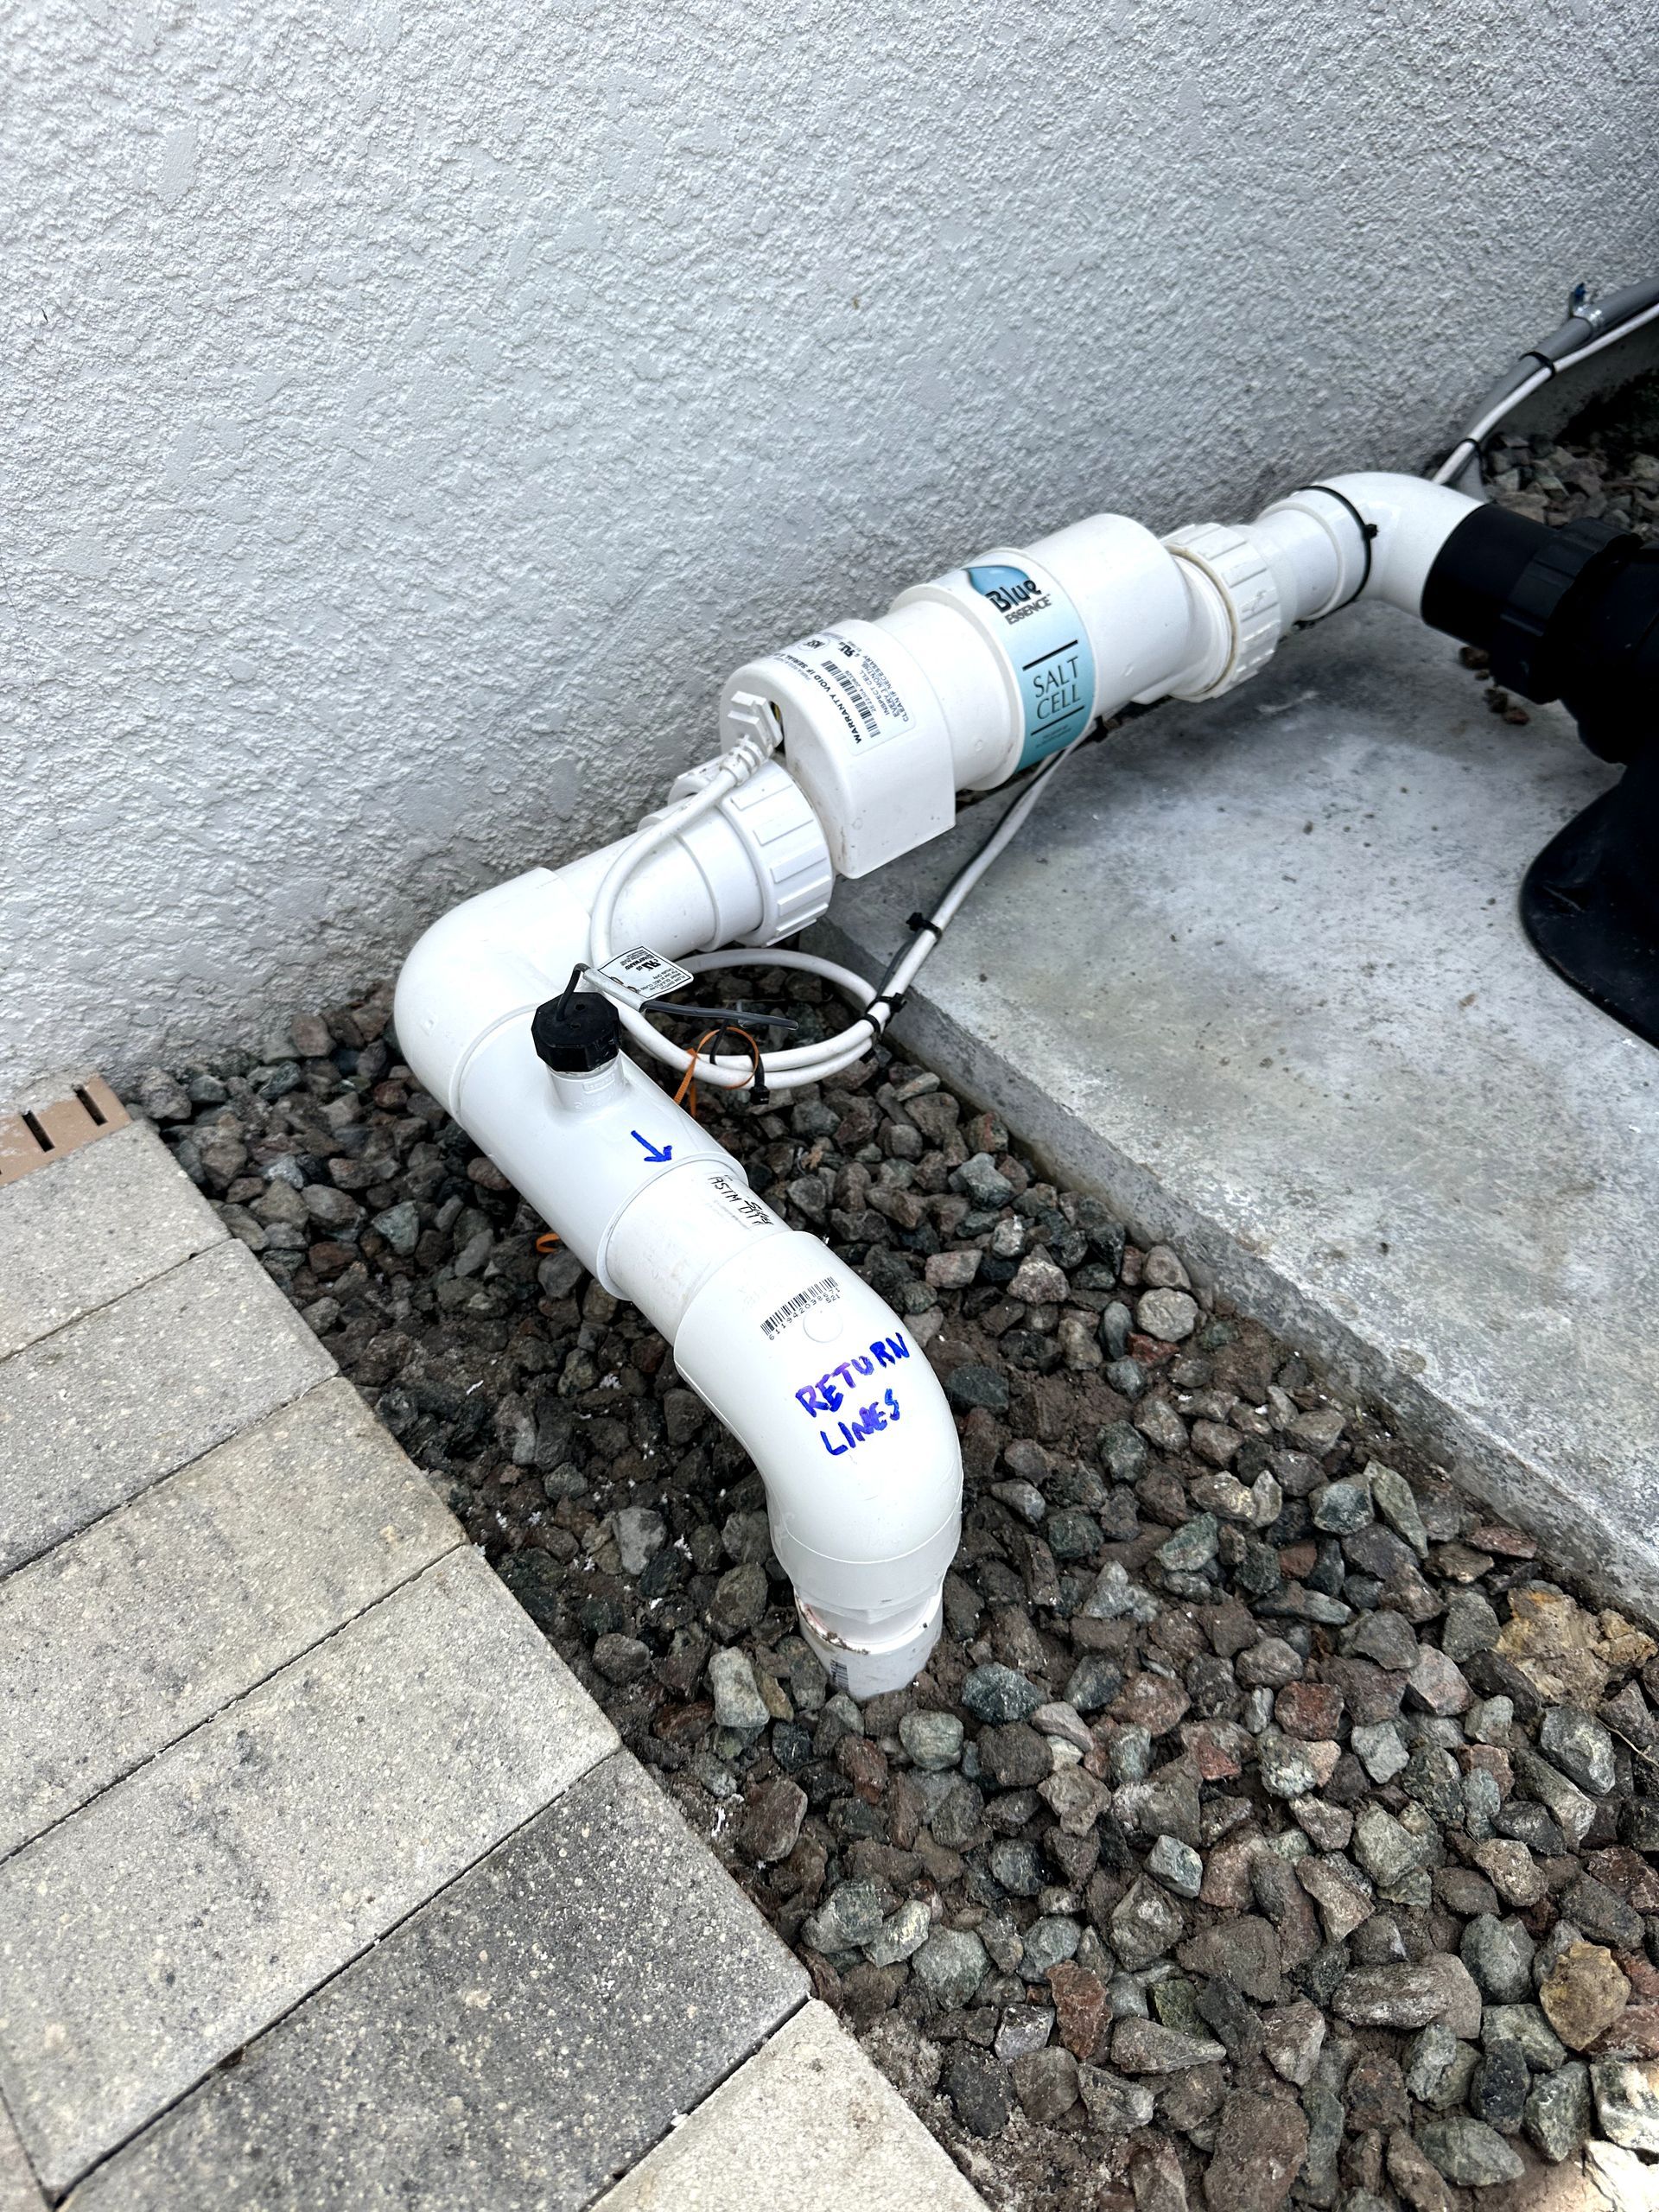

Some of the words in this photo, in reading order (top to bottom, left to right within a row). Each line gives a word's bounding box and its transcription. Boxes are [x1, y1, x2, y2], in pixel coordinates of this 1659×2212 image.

[985, 580, 1042, 613] Blue
[1005, 596, 1052, 626] ESSENCE
[785, 655, 809, 669] SERIAL
[862, 656, 893, 690] NECESSARY
[1033, 656, 1078, 698] SALT
[813, 675, 831, 692] VOID
[860, 670, 873, 685] CELL
[870, 686, 890, 716] INSPECT
[884, 694, 900, 718] EVERY
[894, 697, 909, 722] CLEAN
[1037, 684, 1081, 720] CELL
[829, 693, 862, 744] WARRANTY
[708, 1176, 741, 1202] ASTM
[795, 1332, 910, 1418] RETURN
[819, 1388, 900, 1456] LINES
